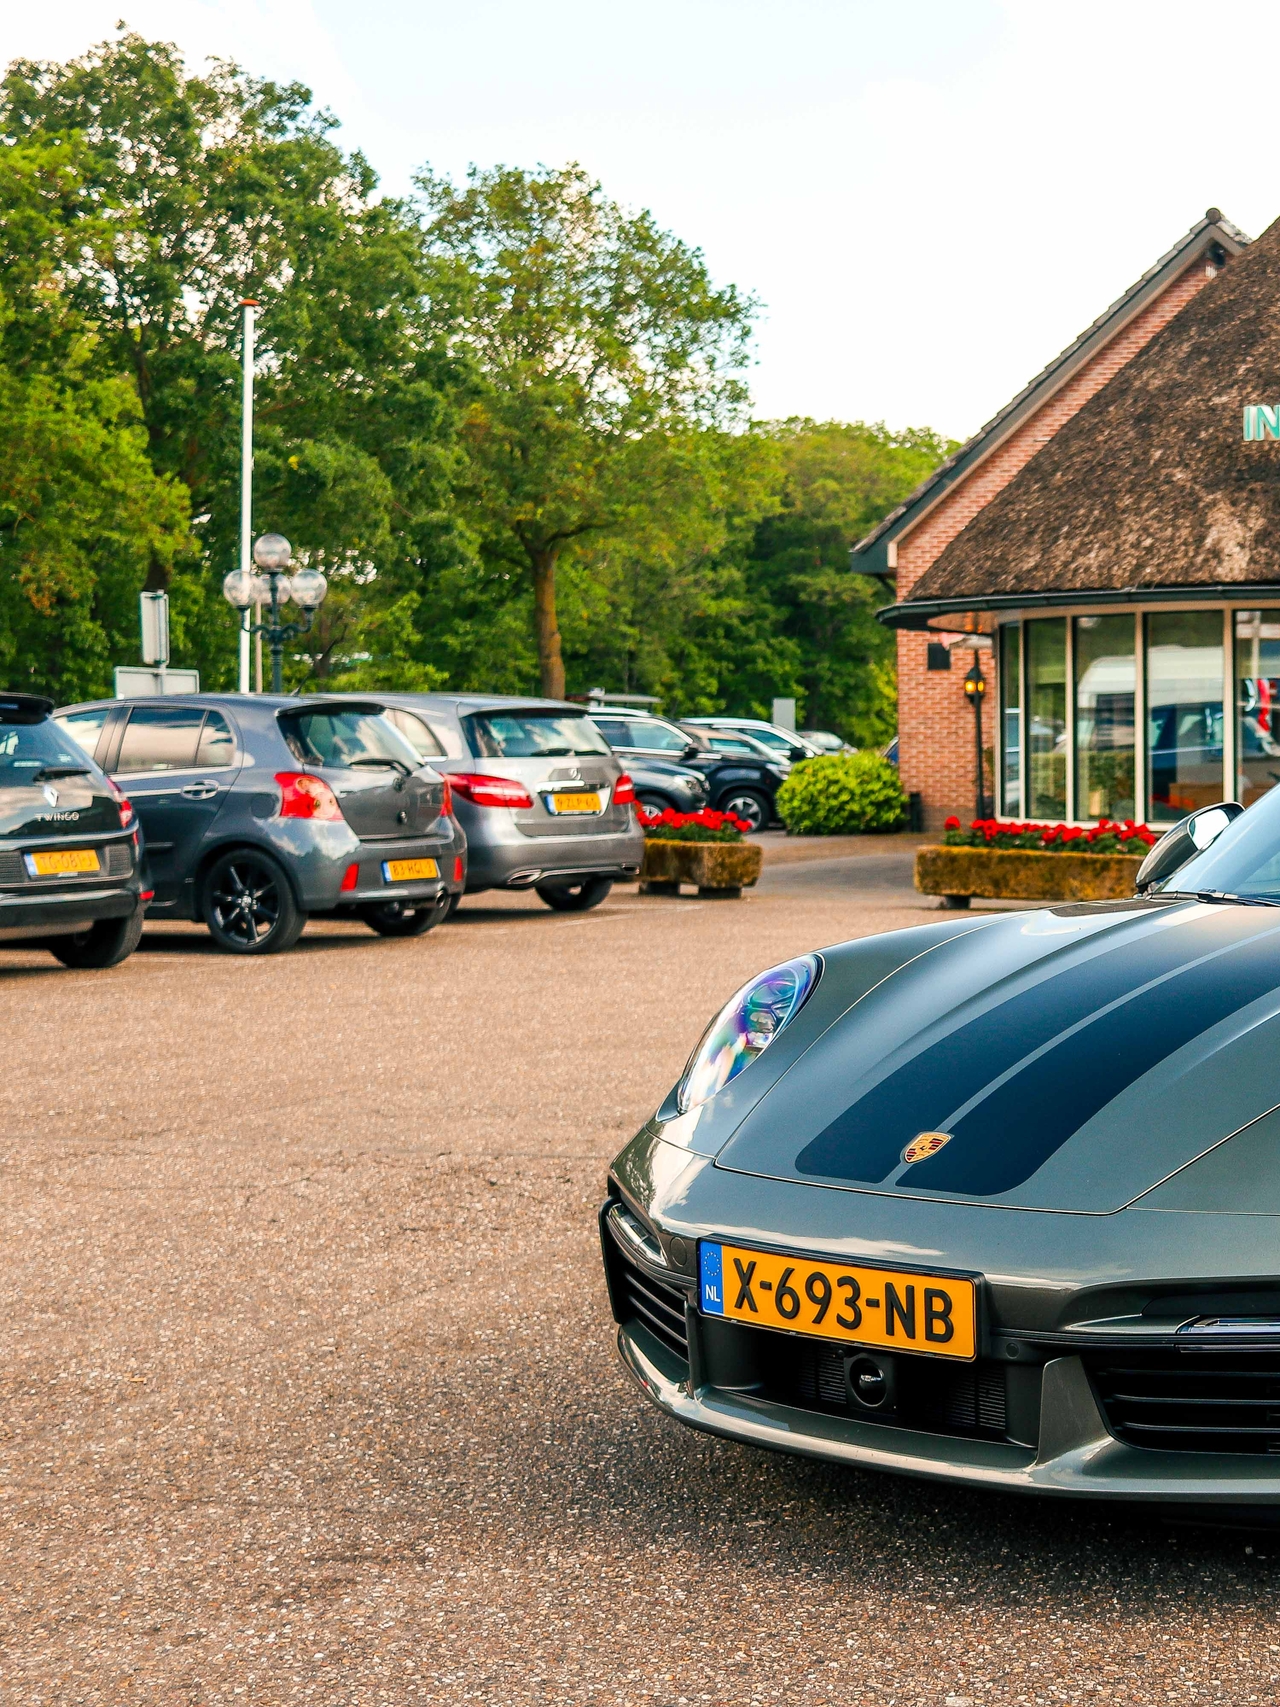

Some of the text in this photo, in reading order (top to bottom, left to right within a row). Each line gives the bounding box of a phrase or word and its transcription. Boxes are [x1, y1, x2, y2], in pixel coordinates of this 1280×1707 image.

[34, 811, 80, 822] TWINGO
[705, 1257, 954, 1343] NL X-693-NB
